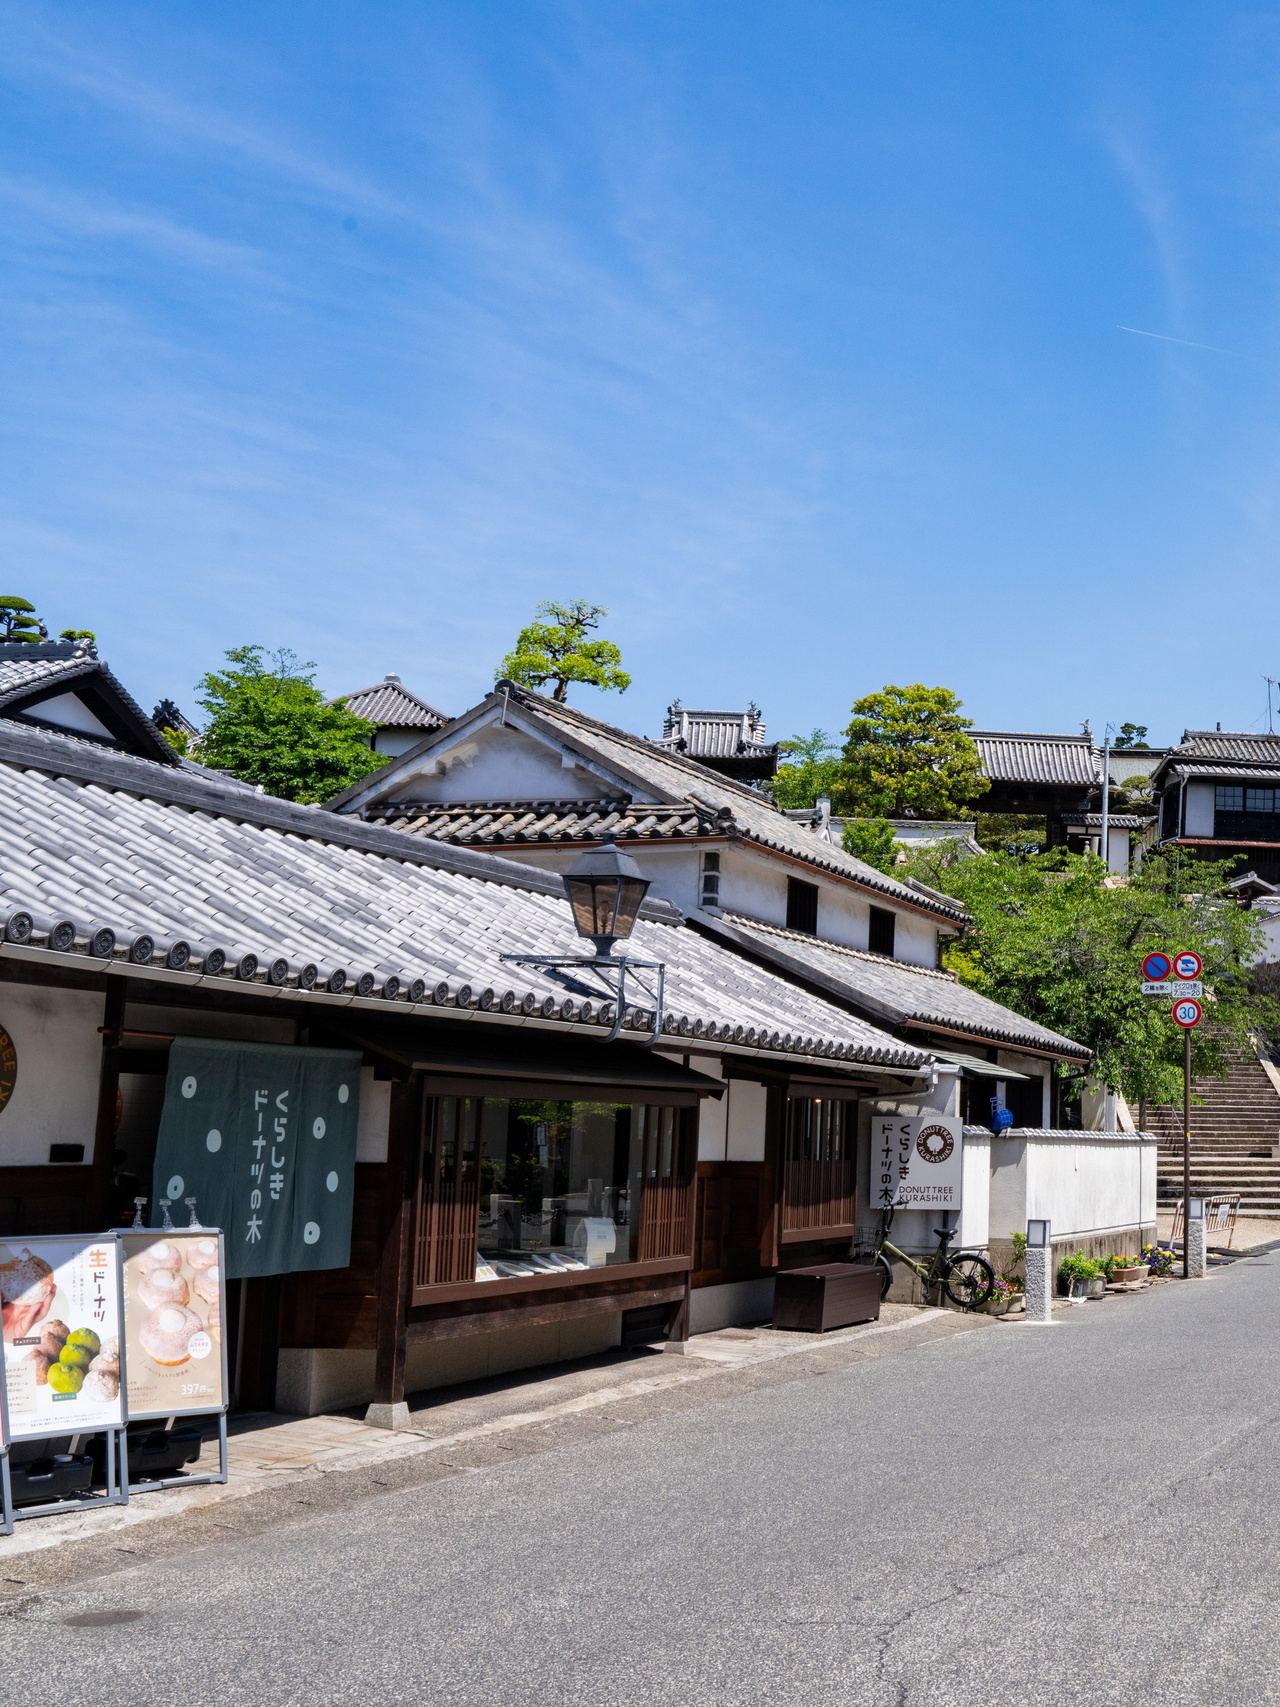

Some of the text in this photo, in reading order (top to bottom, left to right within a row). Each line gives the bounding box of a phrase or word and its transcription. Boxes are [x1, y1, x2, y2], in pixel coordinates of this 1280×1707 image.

[1179, 1006, 1196, 1020] 30
[245, 1089, 268, 1244] ドーナツの木
[269, 1089, 289, 1200] くらしき
[879, 1123, 893, 1202] ドーナツの木
[899, 1124, 911, 1180] くらしき
[918, 1145, 952, 1163] KURASHIKI
[899, 1194, 953, 1202] KURASHIKI
[88, 1249, 108, 1322] 生ドーナツ
[181, 1383, 207, 1396] 397円
